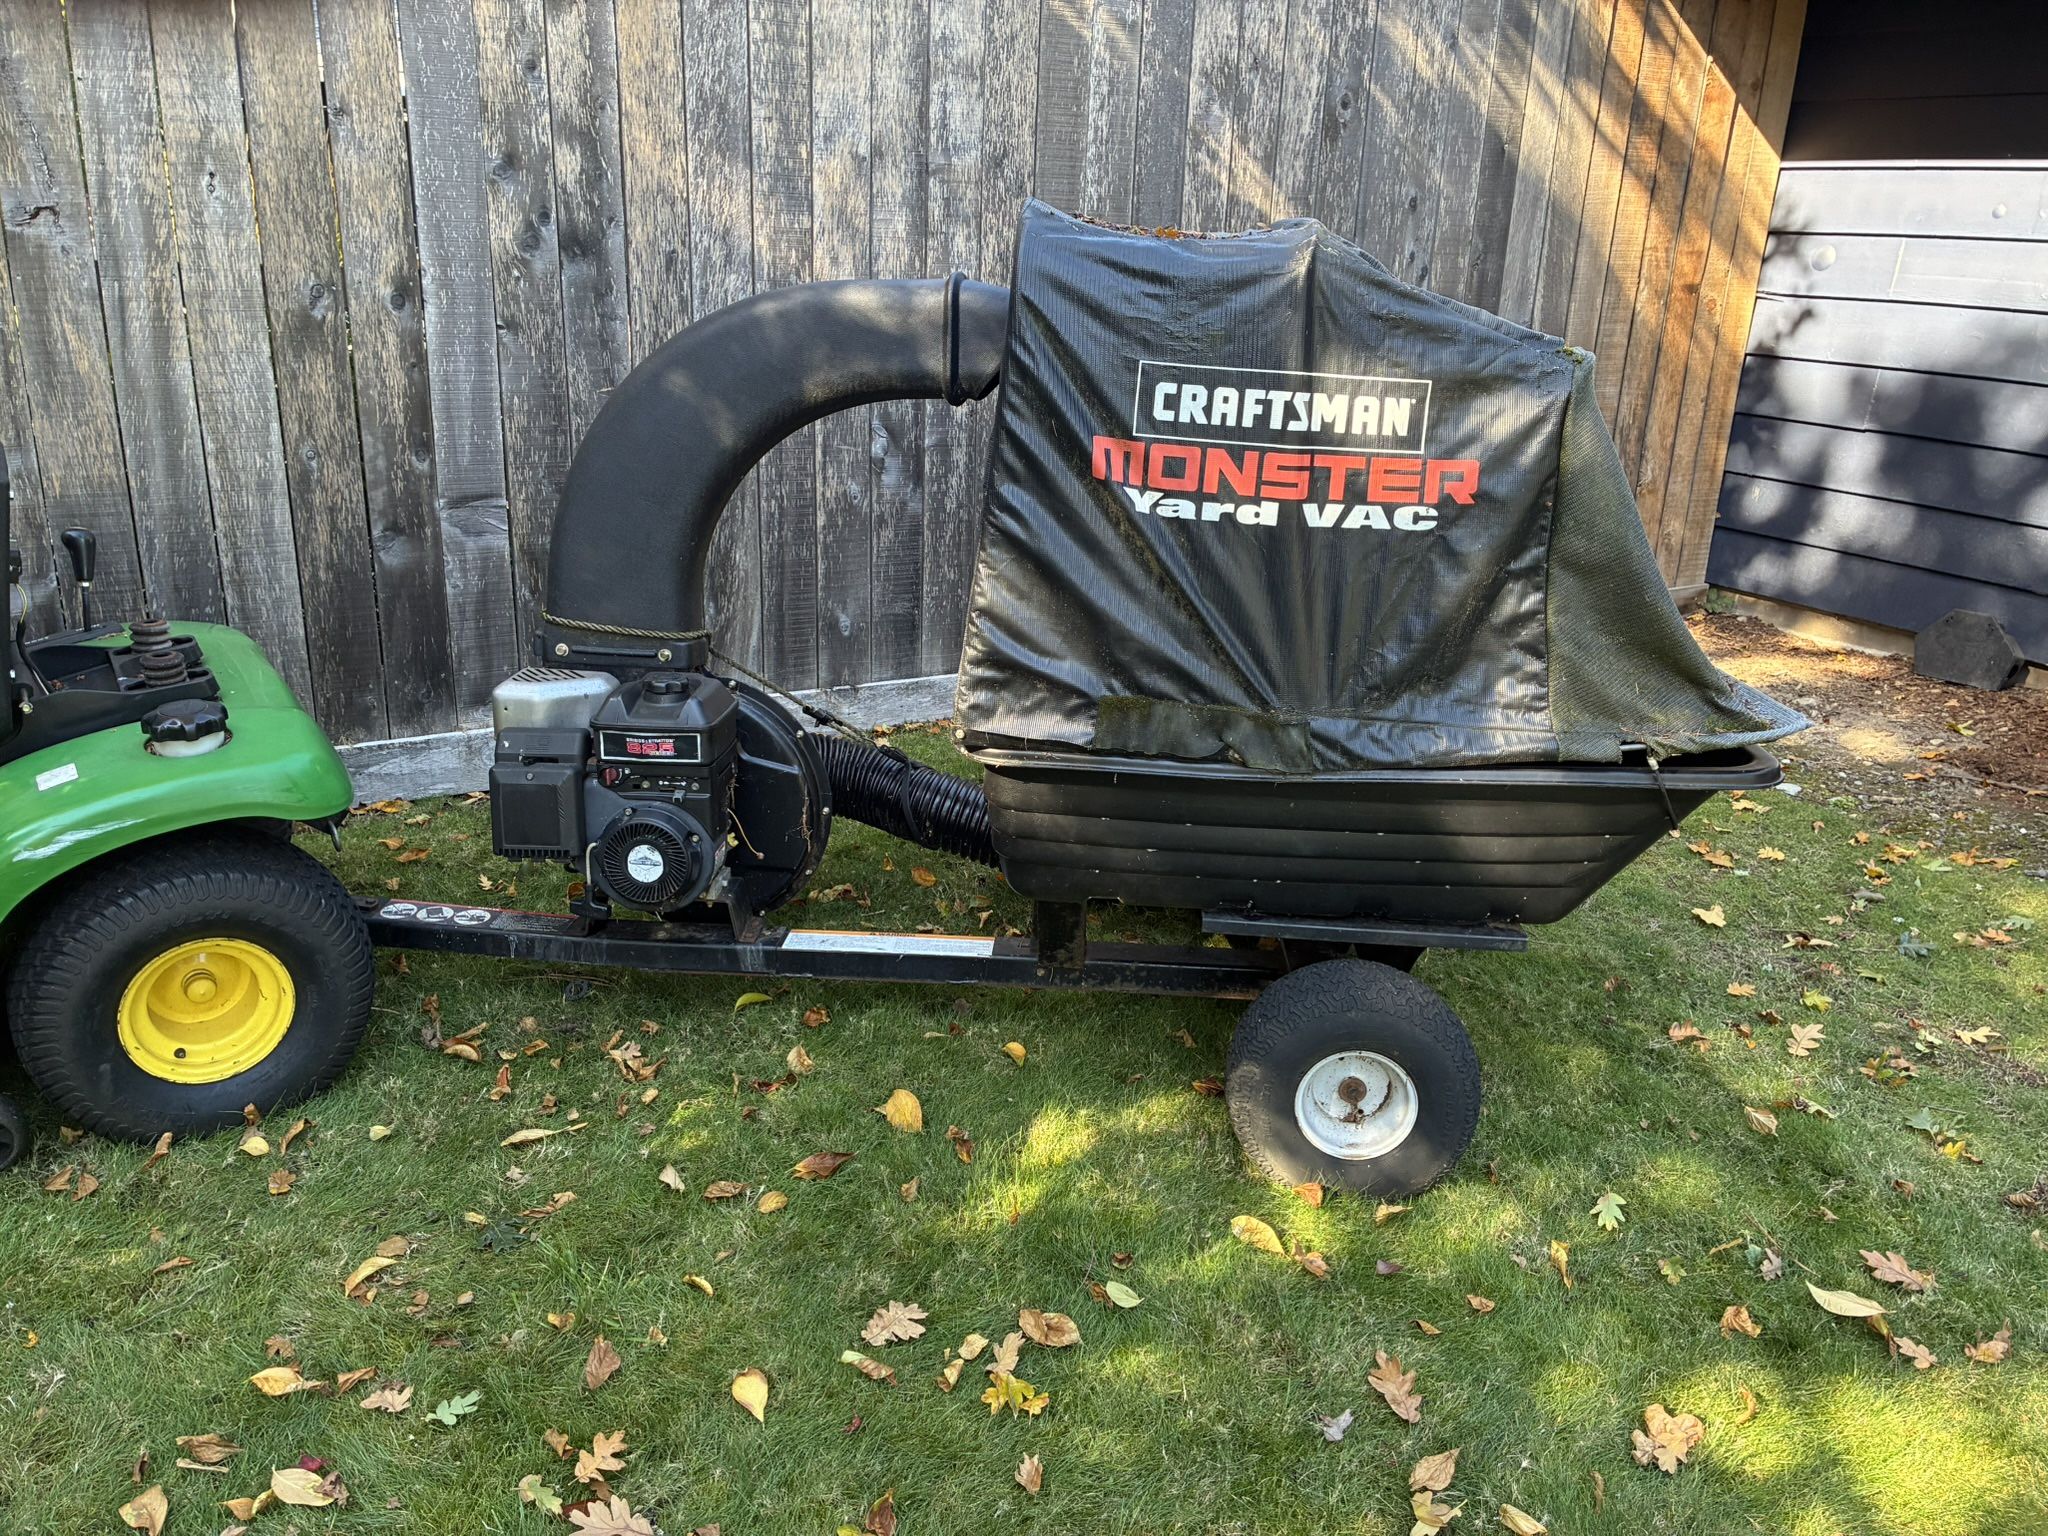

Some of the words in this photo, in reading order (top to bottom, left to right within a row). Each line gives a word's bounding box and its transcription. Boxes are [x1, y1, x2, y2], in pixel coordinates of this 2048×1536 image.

[1152, 381, 1411, 436] CRAFTSMAN
[1091, 435, 1480, 505] MONSTER
[1123, 486, 1279, 527] Yard
[1302, 503, 1438, 531] VAC
